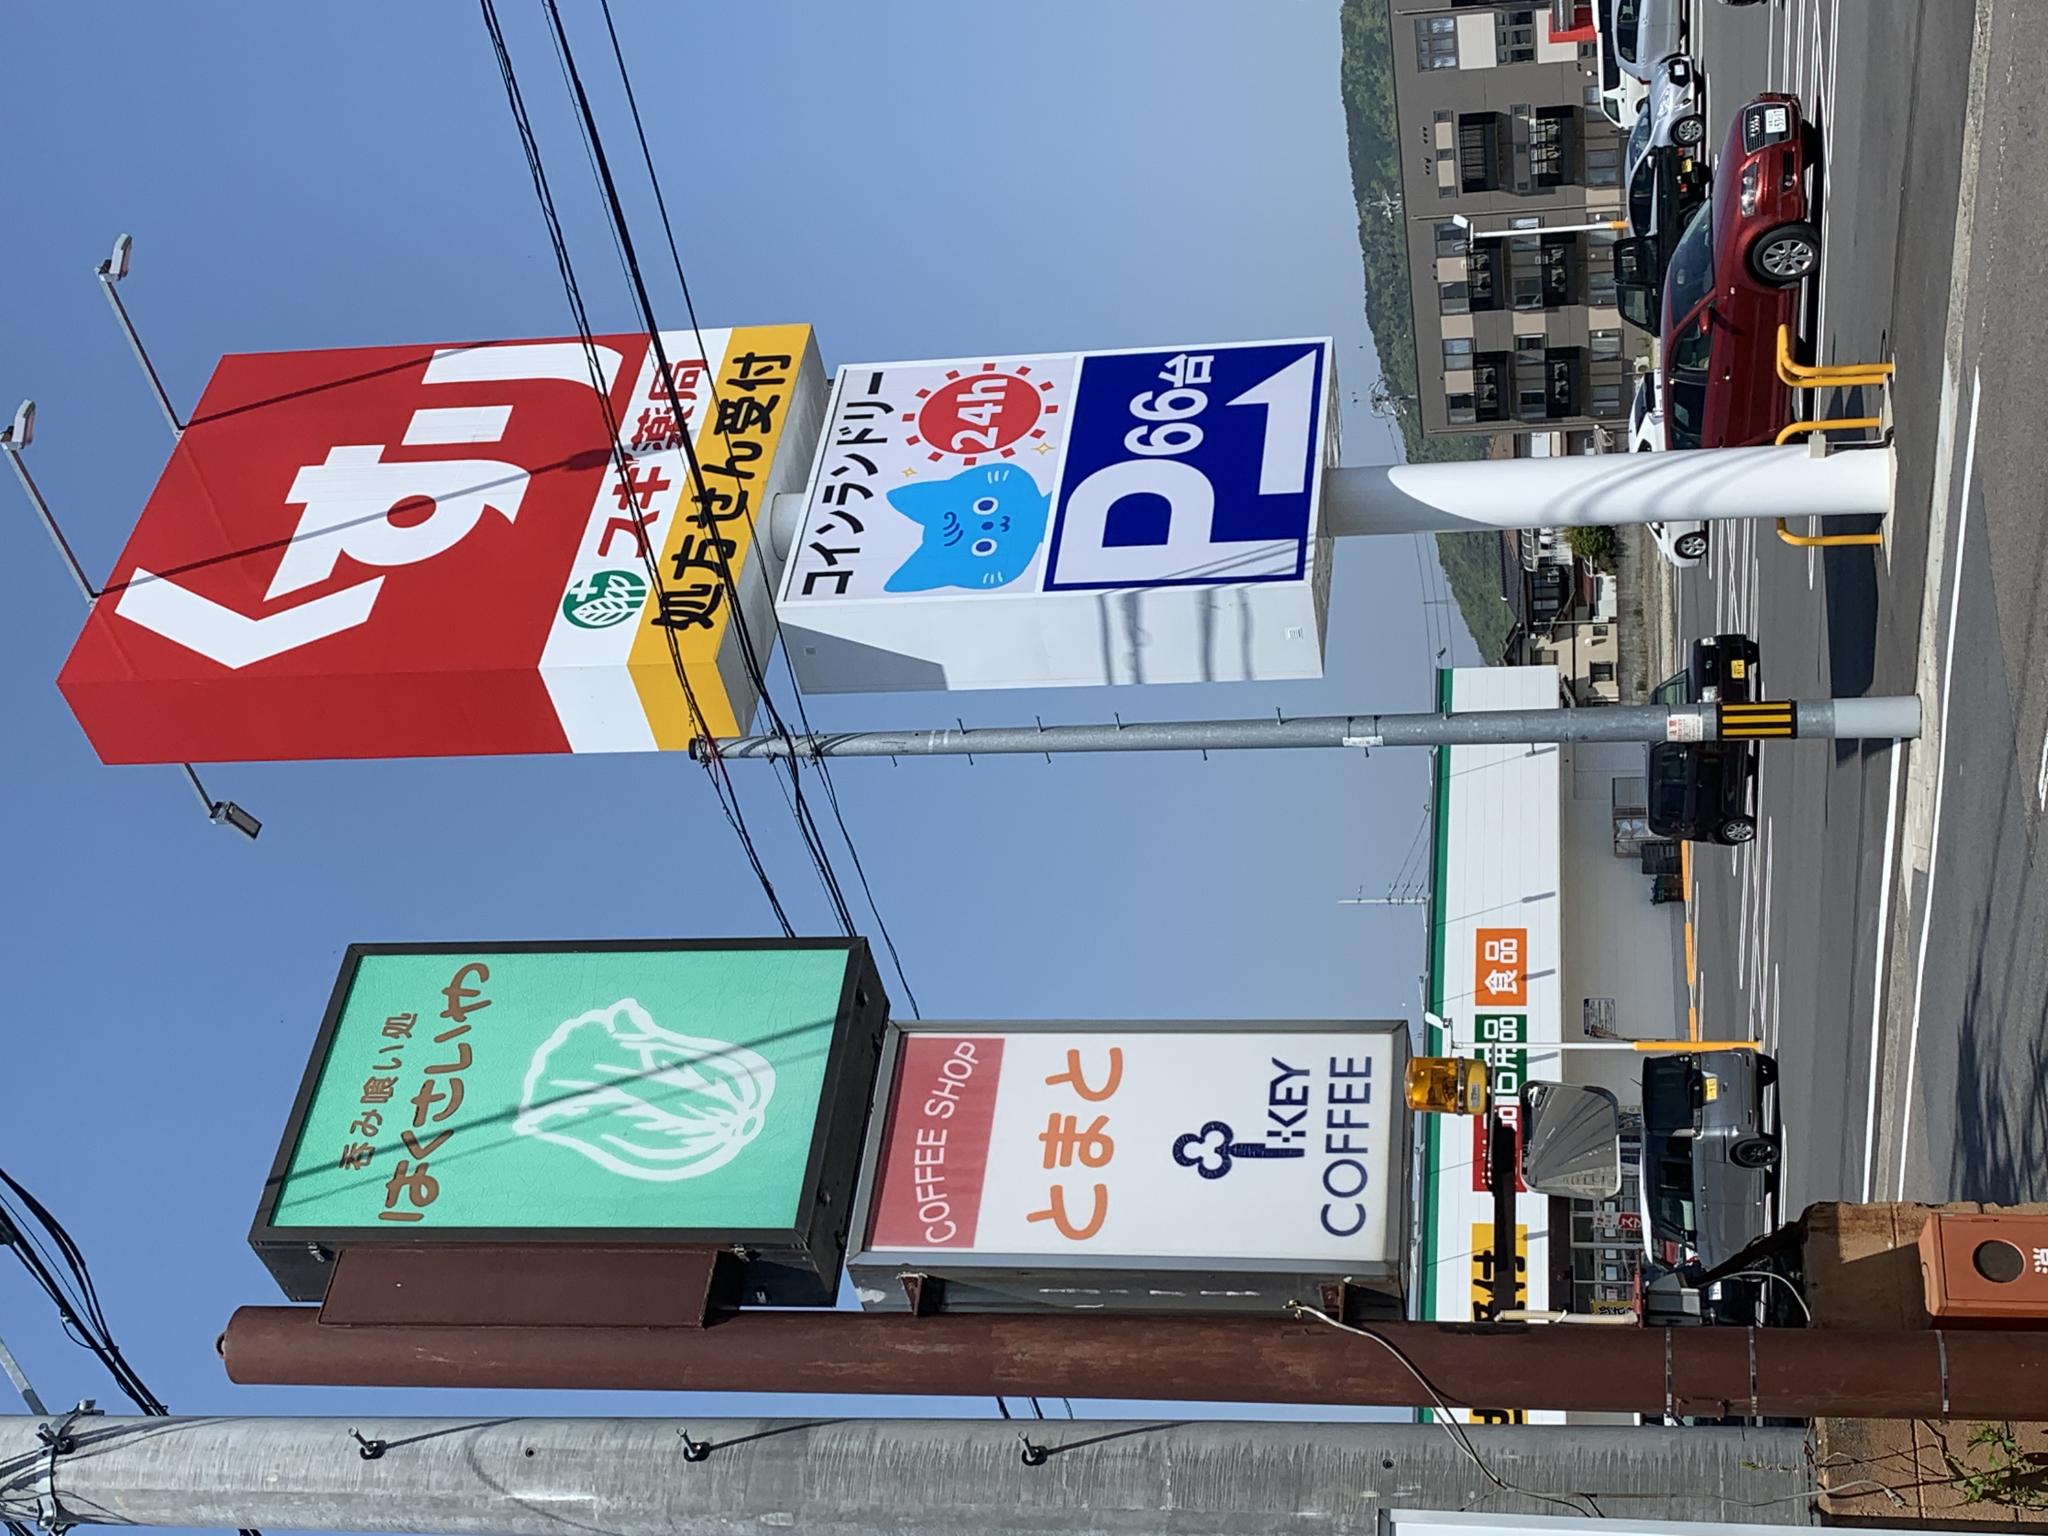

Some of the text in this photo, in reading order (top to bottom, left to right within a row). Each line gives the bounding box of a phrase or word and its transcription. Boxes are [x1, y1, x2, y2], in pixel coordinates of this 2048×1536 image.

[596, 360, 707, 557] スギ薬局
[651, 351, 793, 632] 処方せん受付
[800, 370, 895, 596] コインランドリー
[950, 376, 1010, 451] 24h
[1123, 353, 1216, 456] 66台
[114, 343, 624, 669] くすり
[1053, 457, 1300, 585] P
[1483, 937, 1519, 996] 食品
[339, 1013, 417, 1170] 呑み喰い処
[378, 962, 491, 1222] はくさいや
[913, 1040, 980, 1244] COFFEE SHOP
[1026, 1047, 1123, 1241] とまと
[1265, 1056, 1311, 1143] KEY
[1319, 1055, 1373, 1238] COFFEE
